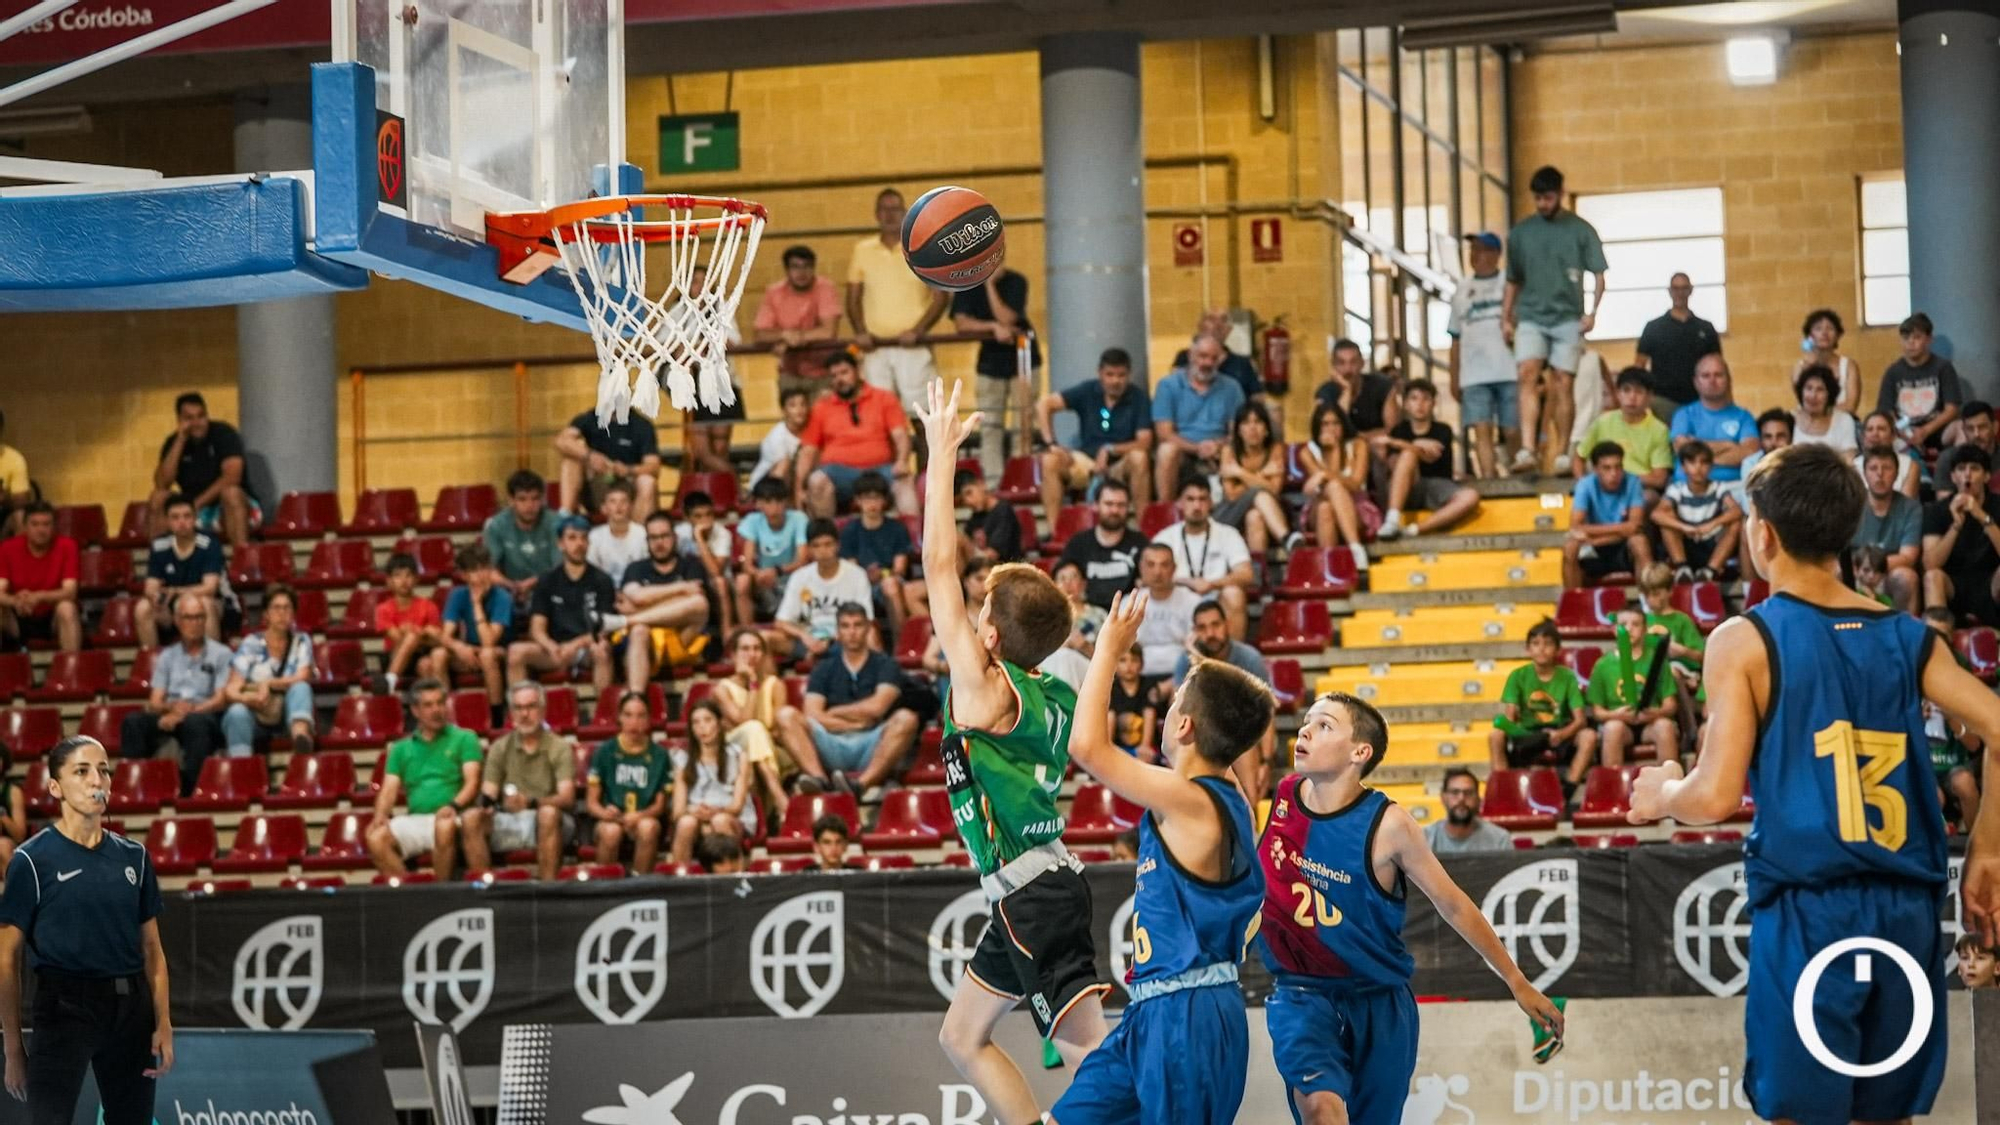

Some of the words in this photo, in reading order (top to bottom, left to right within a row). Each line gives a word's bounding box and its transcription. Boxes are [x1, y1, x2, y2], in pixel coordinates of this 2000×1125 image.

[59, 5, 153, 31] Córdoba
[684, 123, 713, 164] F
[938, 216, 998, 254] Wilson
[1814, 720, 1907, 852] 13
[1538, 868, 1569, 882] FEB
[806, 900, 835, 914] FEB
[1291, 881, 1343, 927] 20
[458, 916, 487, 932] FEB
[630, 908, 660, 923] FEB
[287, 924, 315, 939] FEB
